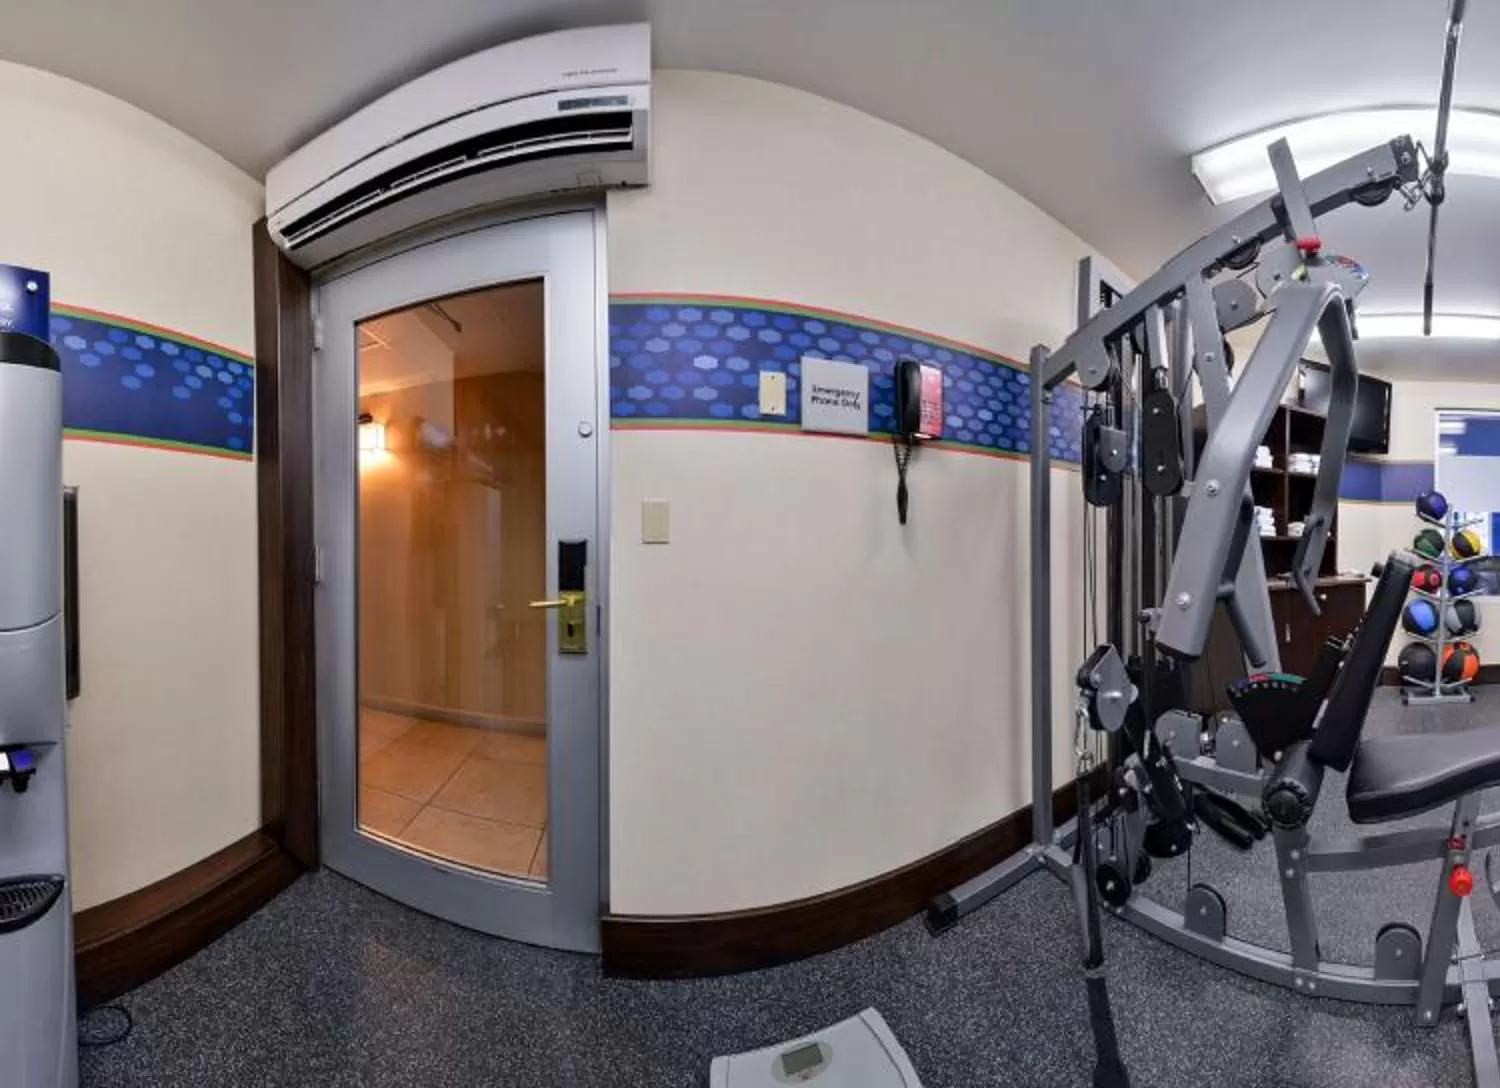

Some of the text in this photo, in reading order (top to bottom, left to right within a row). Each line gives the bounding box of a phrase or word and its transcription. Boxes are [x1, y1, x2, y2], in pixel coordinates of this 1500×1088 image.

[812, 384, 861, 401] Emergency
[811, 395, 861, 411] Phone Only
